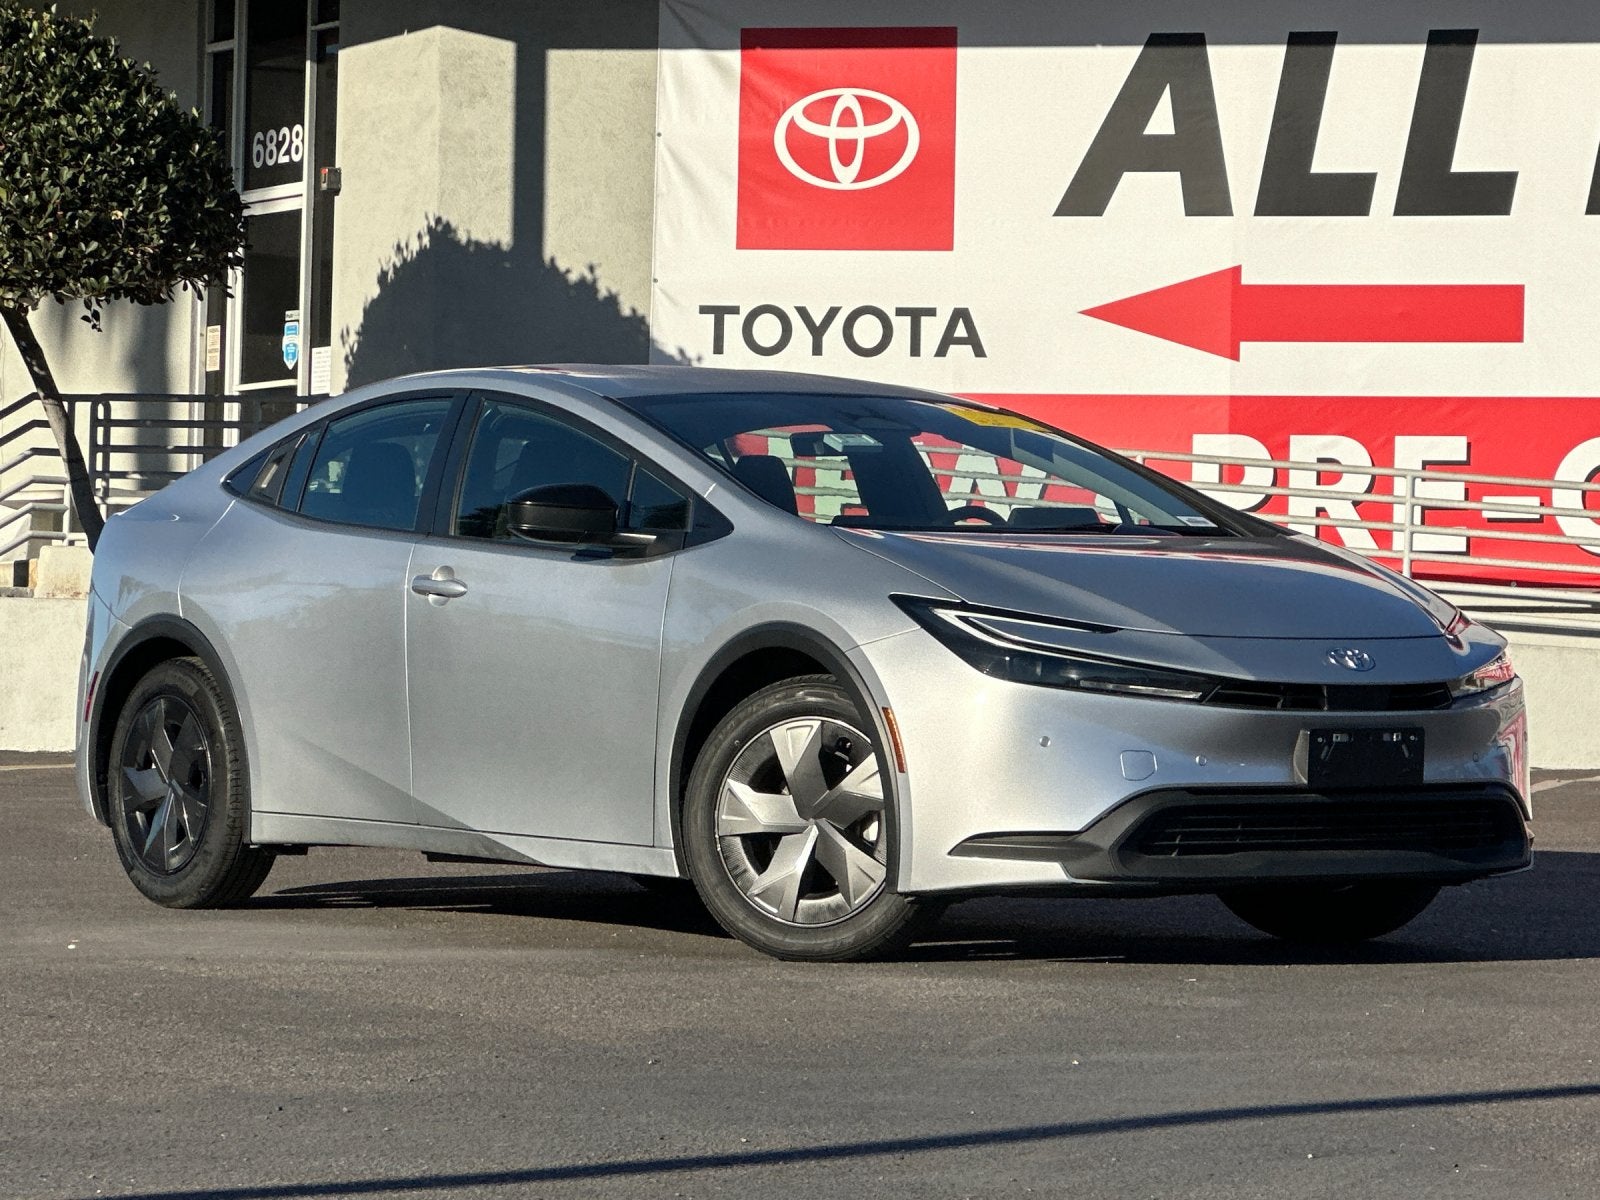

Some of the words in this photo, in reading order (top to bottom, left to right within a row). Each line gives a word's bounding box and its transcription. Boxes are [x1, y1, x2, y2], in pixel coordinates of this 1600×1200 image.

[252, 124, 304, 169] 6828
[1052, 29, 1519, 216] ALL
[699, 304, 987, 358] TOYOTA
